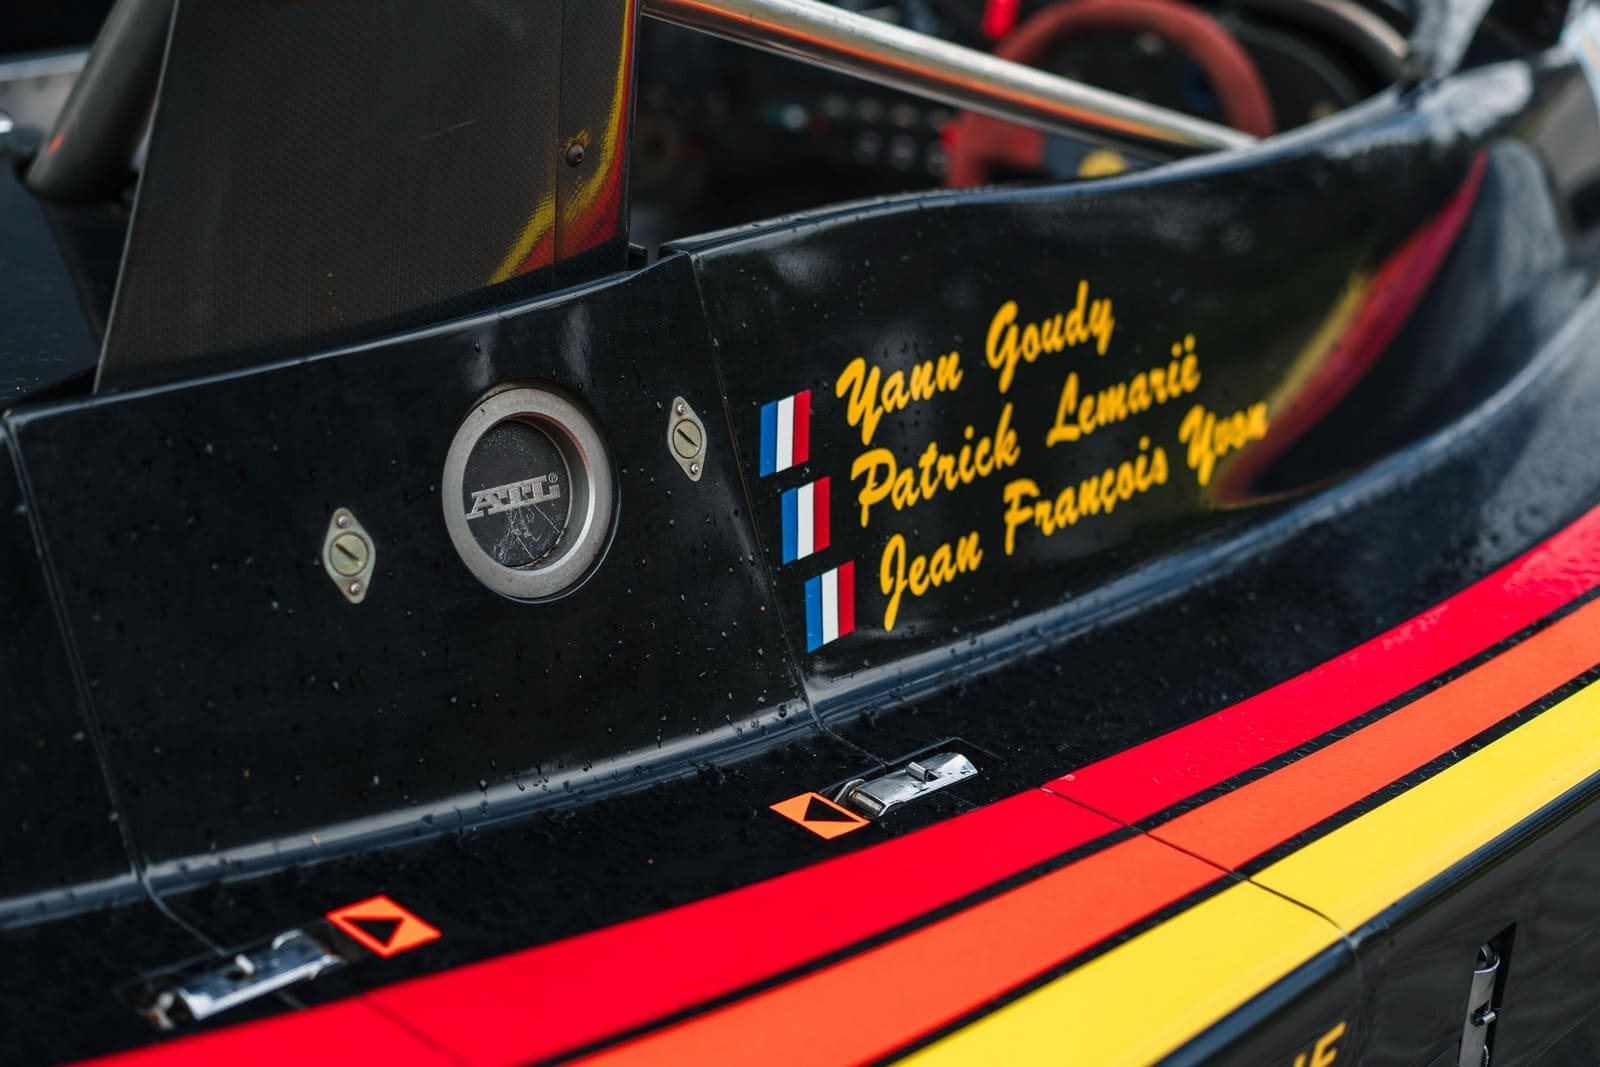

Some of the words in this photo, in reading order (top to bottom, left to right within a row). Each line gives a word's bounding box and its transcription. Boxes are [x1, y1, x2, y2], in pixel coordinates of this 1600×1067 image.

[835, 351, 963, 446] Yann
[986, 280, 1115, 393] Goudy
[850, 402, 1020, 528] Patrick
[879, 531, 983, 632] Jean
[1003, 436, 1168, 555] François
[1179, 402, 1269, 487] Yvon
